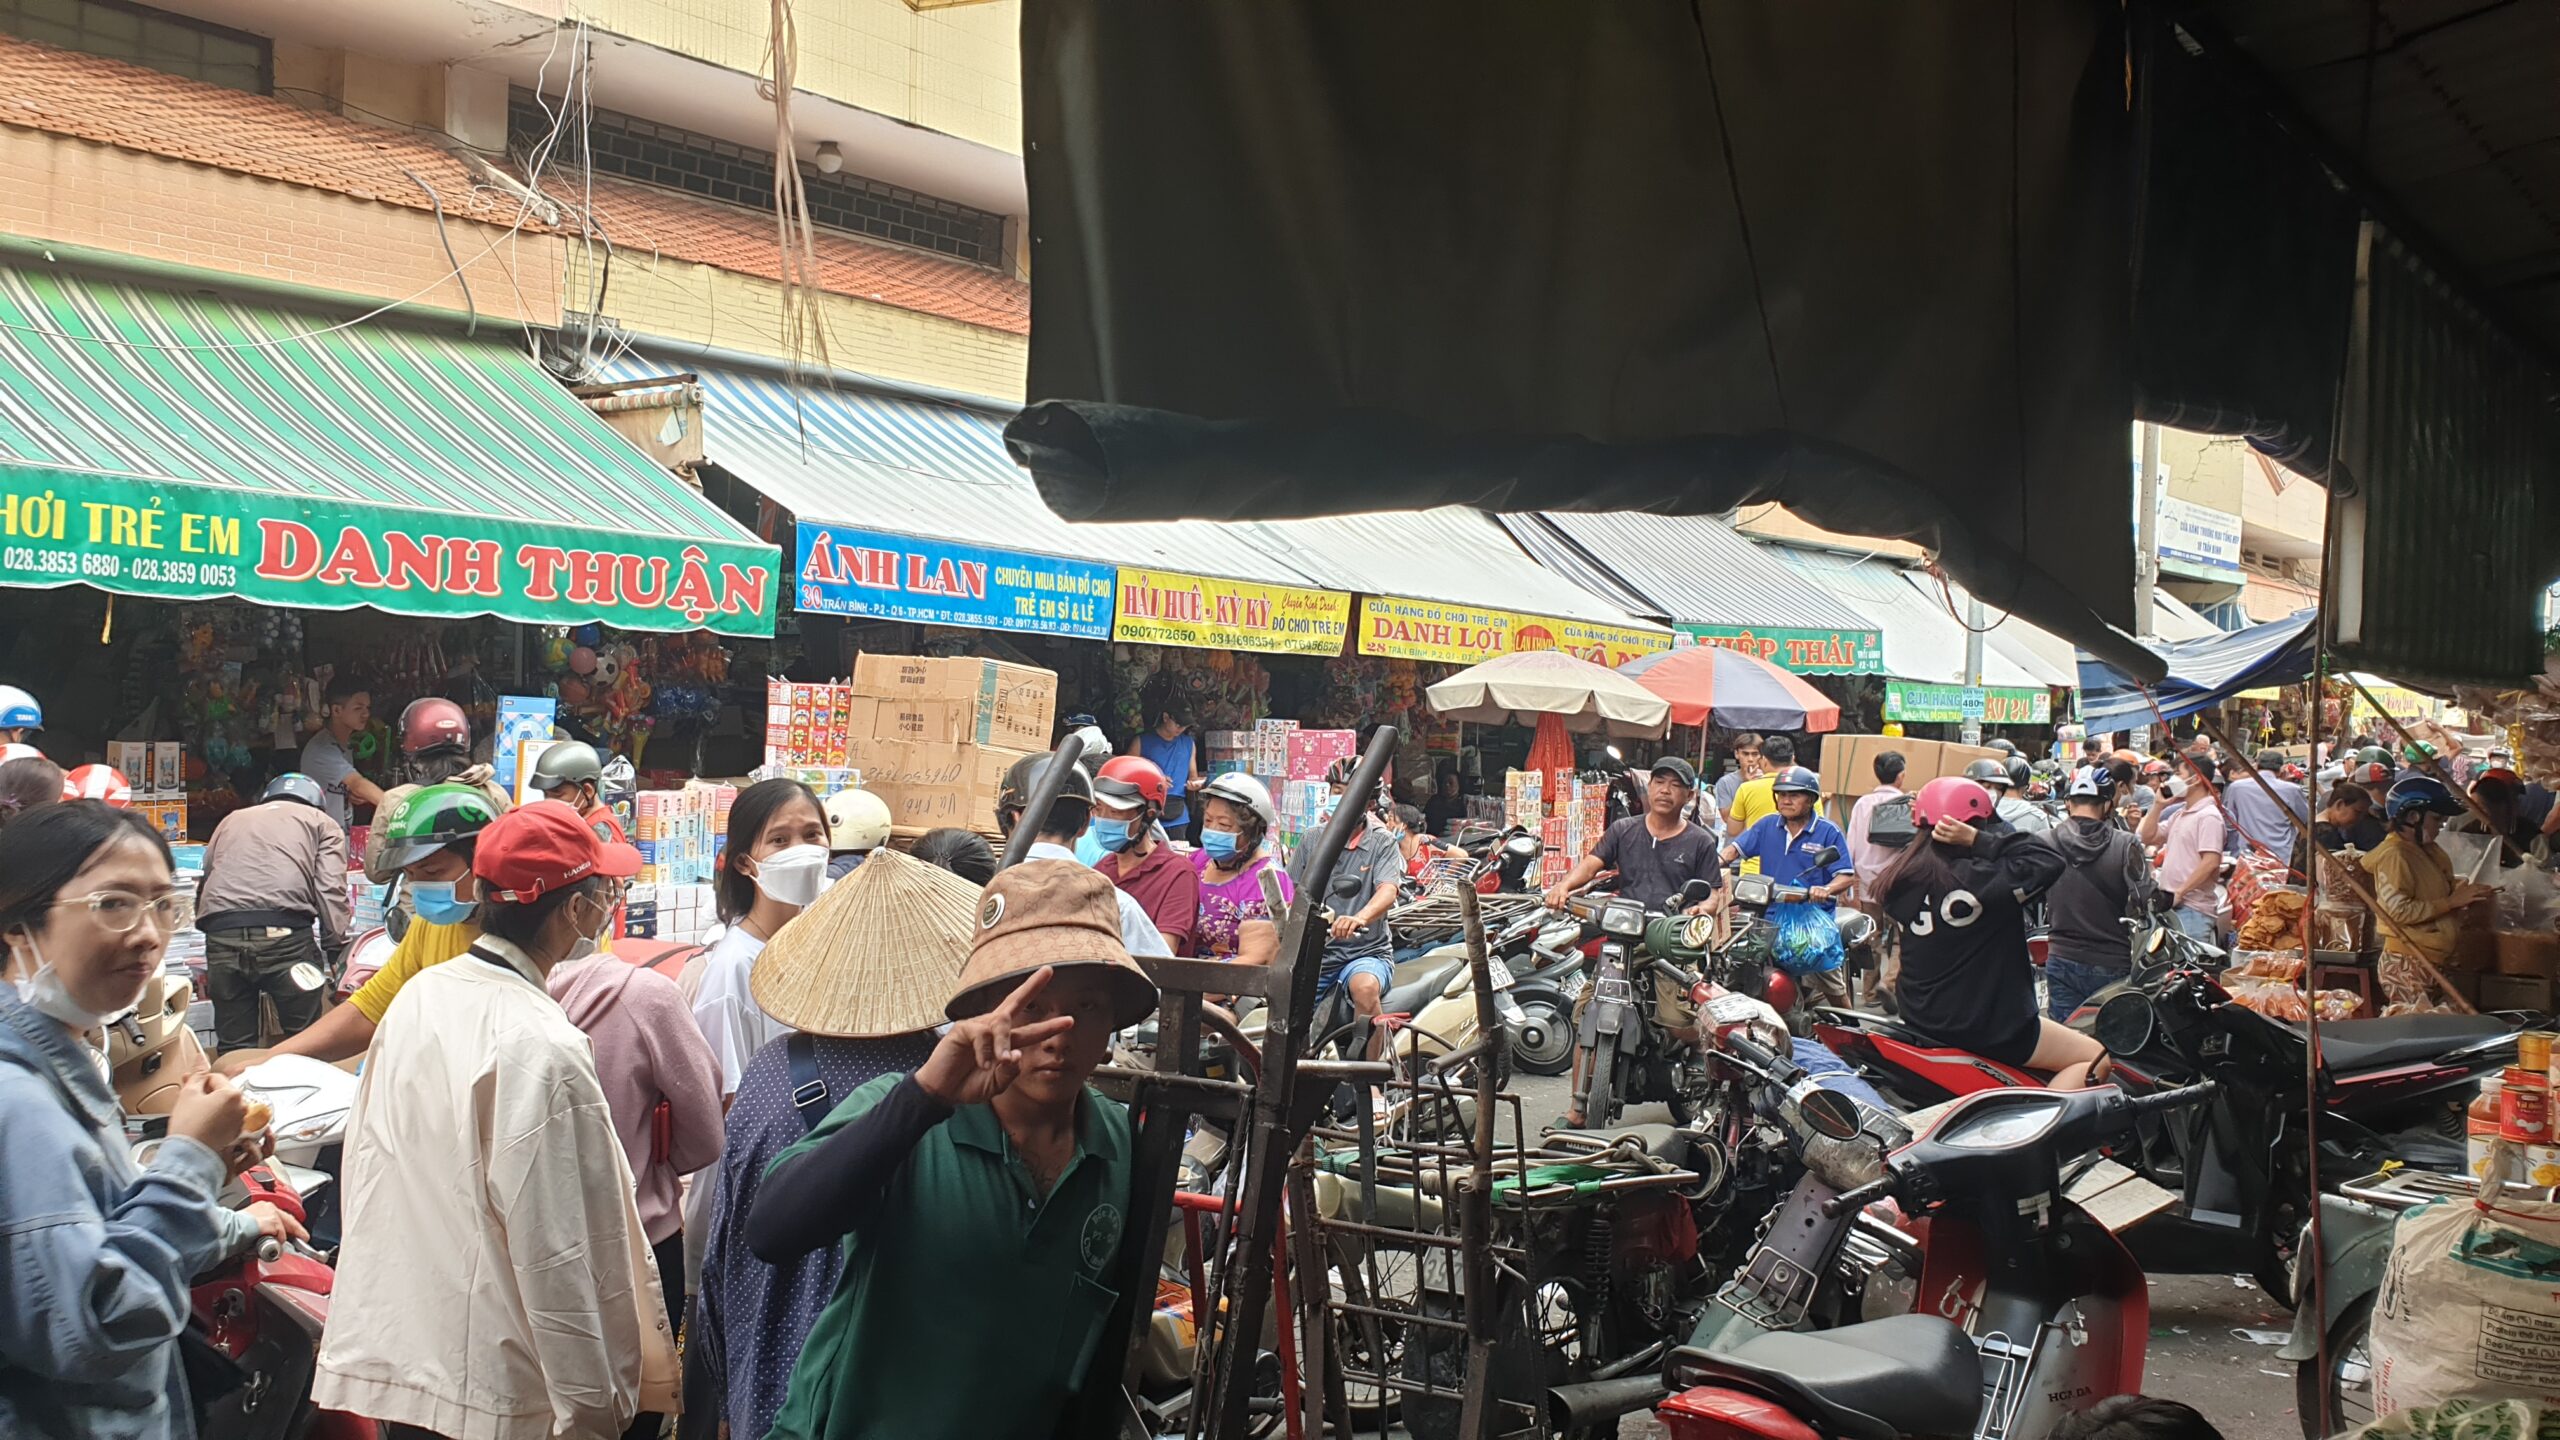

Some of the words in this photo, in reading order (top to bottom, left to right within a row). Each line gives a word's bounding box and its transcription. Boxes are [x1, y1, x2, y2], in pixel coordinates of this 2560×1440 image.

[82, 496, 165, 549] TRẺ
[180, 512, 240, 556] EM
[3, 547, 76, 573] 028.3853
[82, 554, 120, 578] 6880
[132, 558, 196, 584] 028.3859
[201, 564, 236, 587] 0053
[254, 518, 502, 596] DANH
[517, 545, 768, 623] THUẬN
[802, 531, 900, 590] ÁNH
[906, 553, 988, 601] LAN
[995, 565, 1032, 588] CHUYÊN
[1035, 571, 1055, 590] MUA
[1057, 570, 1076, 593] BÁN
[1078, 570, 1090, 595] ĐỒ
[1092, 578, 1111, 598] CHƠI
[802, 584, 822, 609] 30
[848, 599, 868, 613] BÌNH
[908, 607, 935, 619] TP.HCM
[1015, 591, 1036, 616] TRẺ
[1040, 599, 1055, 618] EM
[1071, 606, 1079, 620] &
[1081, 598, 1095, 622] LẺ
[1123, 575, 1160, 619] HẢI
[1163, 584, 1203, 623] HUÊ
[1216, 589, 1243, 627] KỲ
[1245, 591, 1272, 629] KỲ
[1369, 600, 1391, 614] CỬA
[1395, 604, 1424, 618] HÀNG
[1427, 607, 1441, 620] ĐỒ
[1445, 611, 1468, 623] CHƠI
[1472, 613, 1489, 626] TRẺ
[1493, 617, 1508, 628] EM
[1120, 625, 1196, 641] 0907772650
[1272, 611, 1285, 631] ĐỒ
[1287, 618, 1309, 633] CHƠI
[1312, 615, 1331, 635] TRẺ
[1333, 622, 1345, 636] EM
[1373, 617, 1451, 645] DANH
[1458, 627, 1502, 654] LỢI
[1366, 642, 1386, 653] 28
[1658, 639, 1669, 649] EM
[2010, 698, 2030, 720] 24
